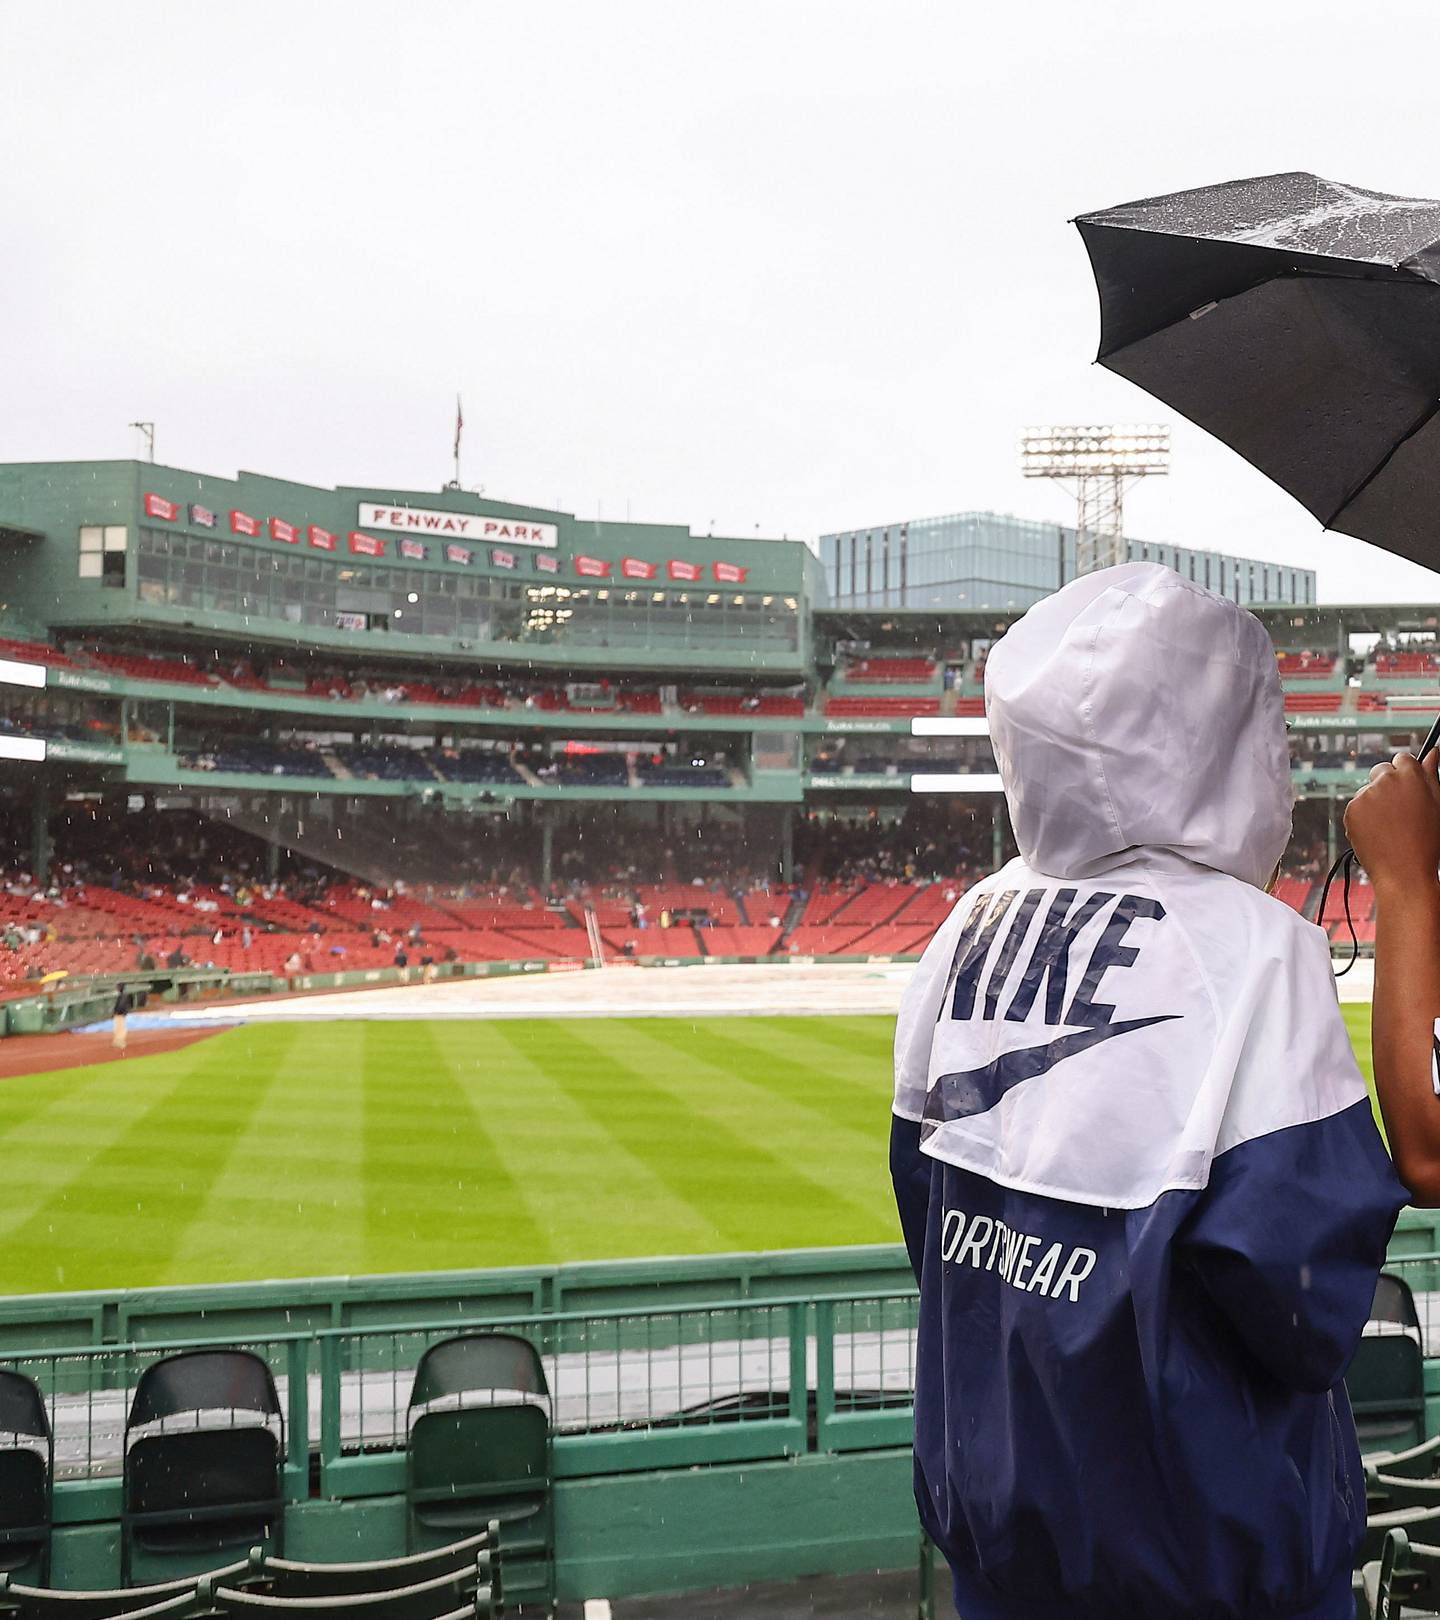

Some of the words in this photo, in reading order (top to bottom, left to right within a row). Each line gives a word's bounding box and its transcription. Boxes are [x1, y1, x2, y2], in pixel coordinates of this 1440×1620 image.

[373, 509, 469, 532] FENWAY
[484, 522, 543, 541] PARK
[937, 888, 1166, 1029] NIKE
[941, 1206, 1097, 1303] ORTSWEAR
